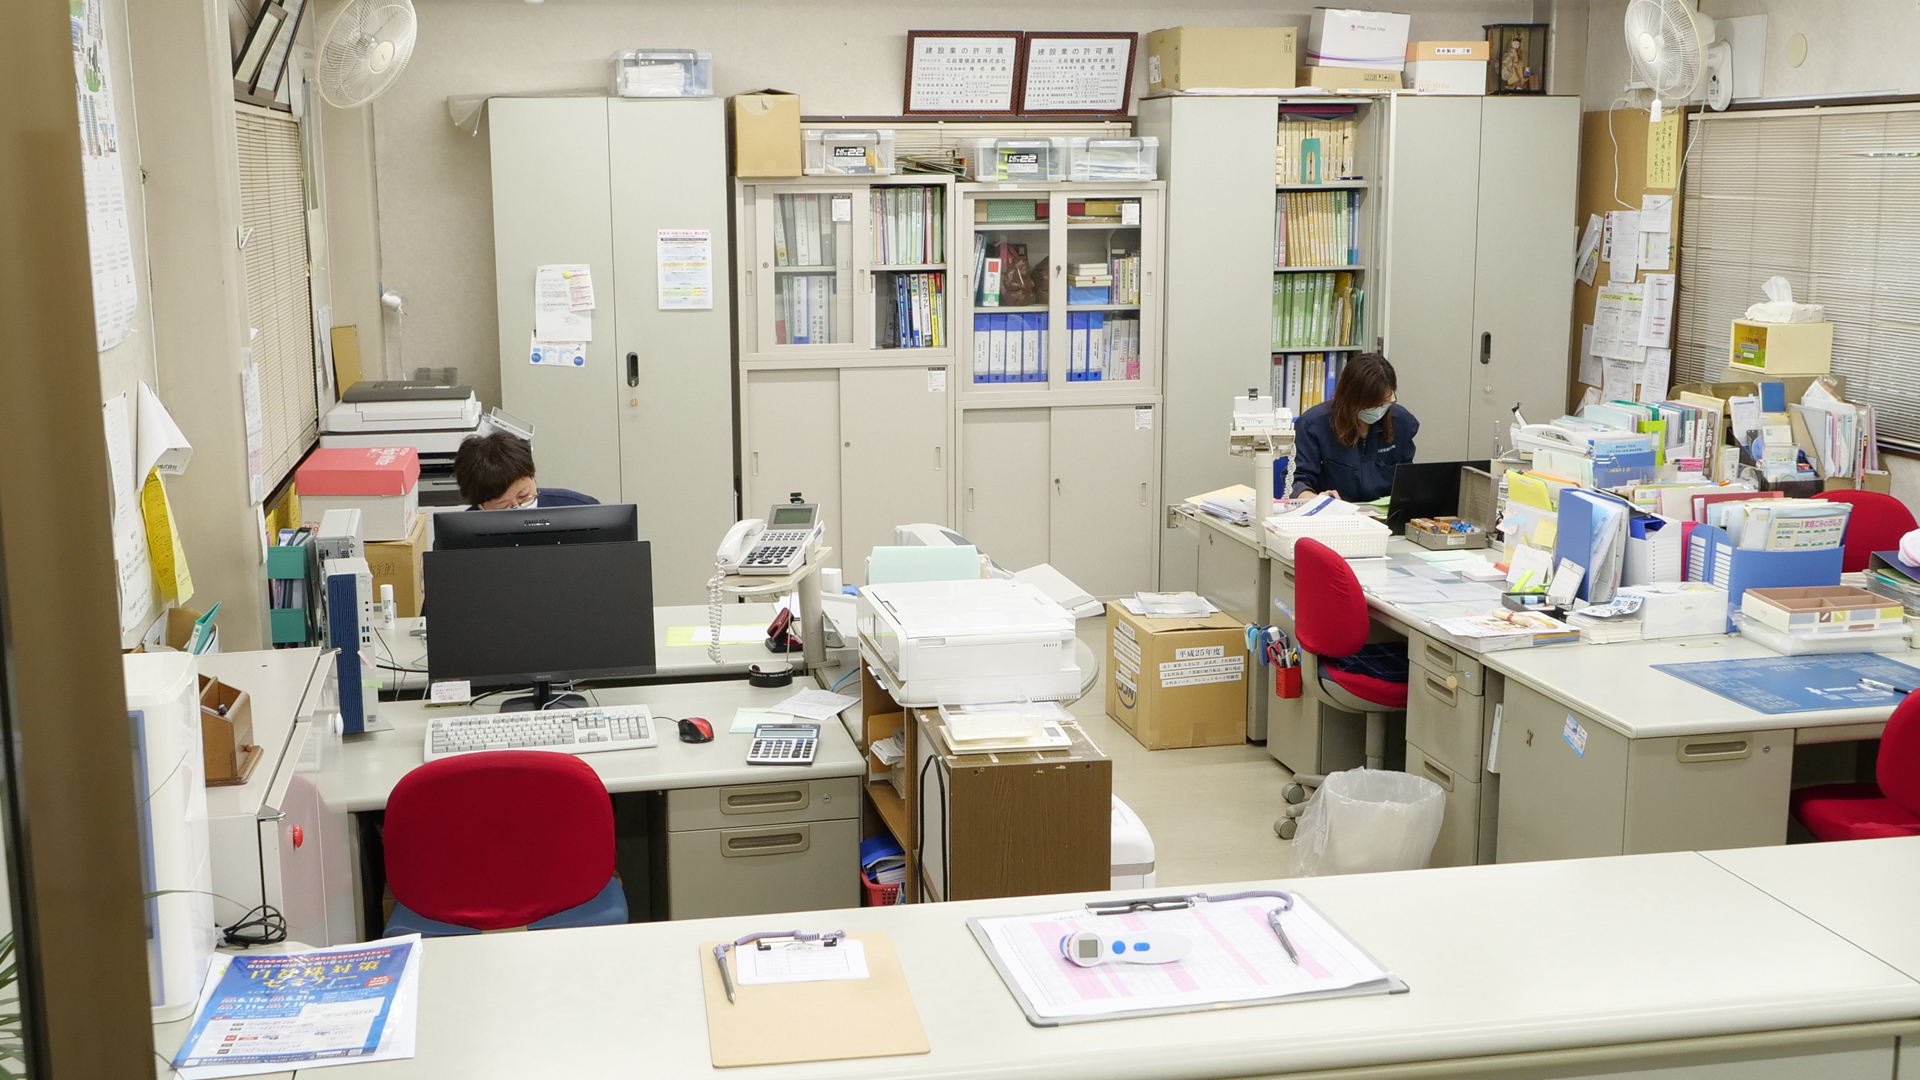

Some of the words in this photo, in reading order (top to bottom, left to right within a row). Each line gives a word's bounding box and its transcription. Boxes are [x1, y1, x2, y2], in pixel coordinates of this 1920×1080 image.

[925, 47, 1004, 55] 建設業の許可票
[1037, 47, 1114, 56] 建設業の許可票
[921, 281, 929, 309] カウネット
[1179, 647, 1222, 658] 平成25年度
[250, 960, 380, 979] 自社株対策
[263, 974, 359, 988] セミナー
